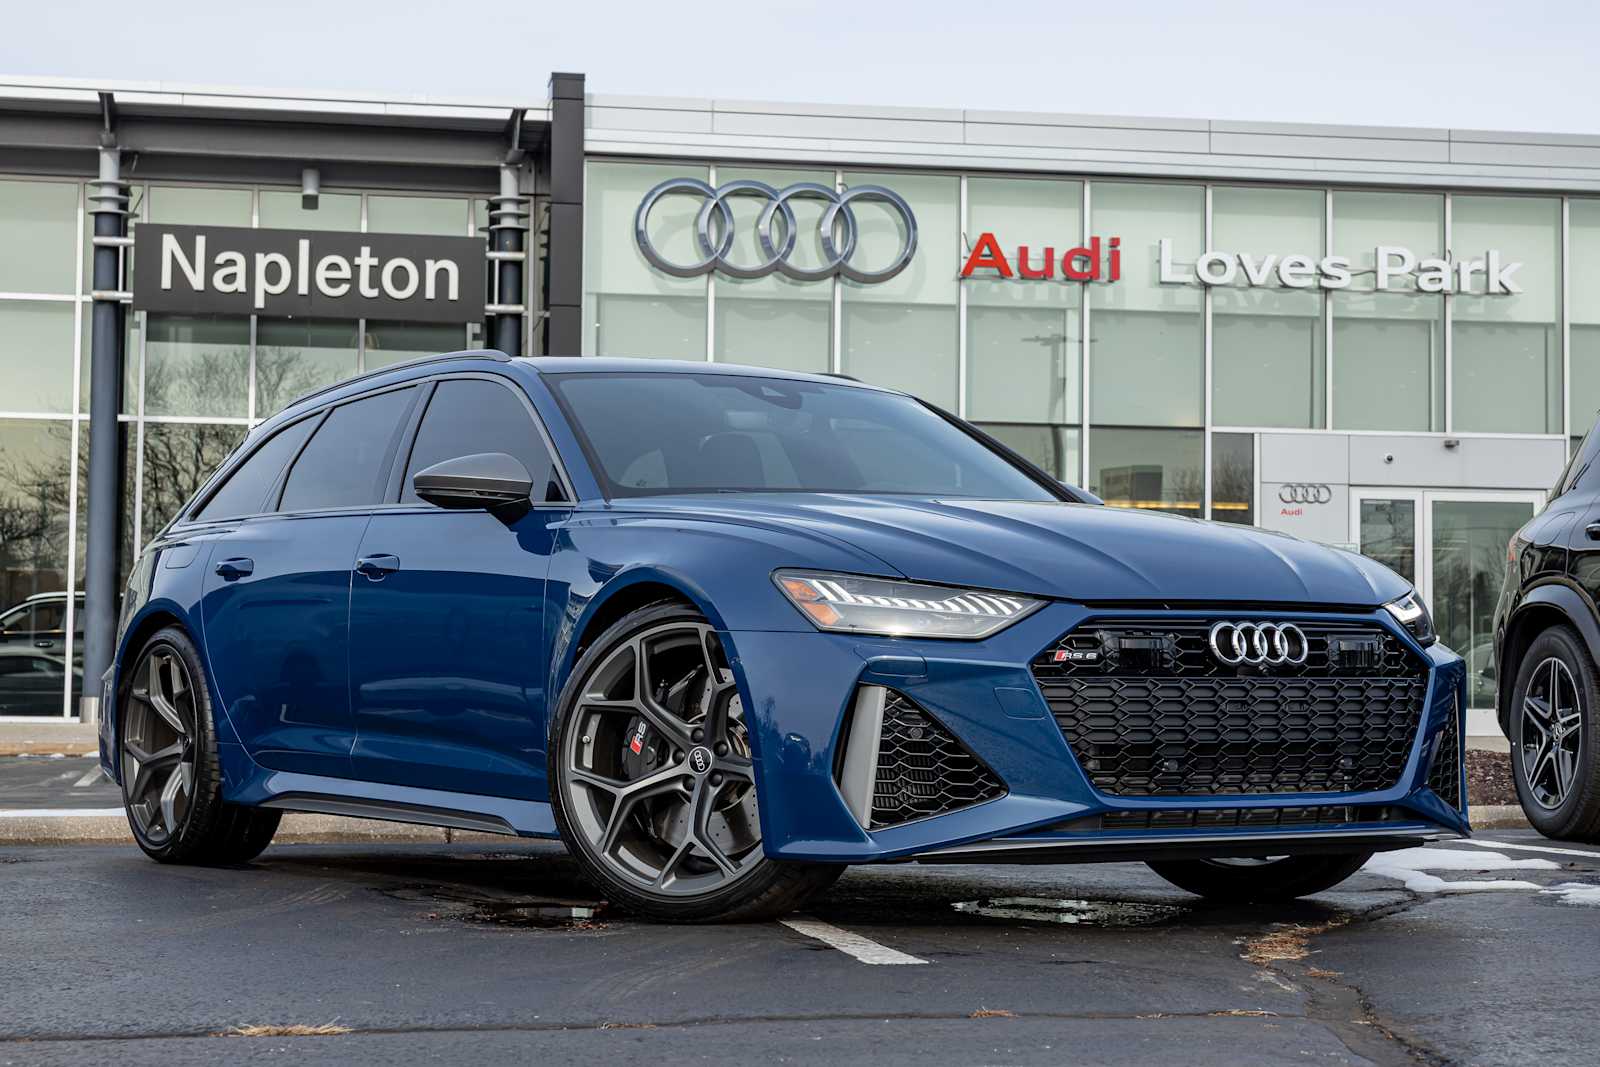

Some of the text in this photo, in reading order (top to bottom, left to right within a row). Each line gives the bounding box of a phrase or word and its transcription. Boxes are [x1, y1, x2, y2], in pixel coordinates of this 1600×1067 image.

[160, 233, 460, 309] Napleton
[960, 232, 1524, 295] Audi Loves Park
[1280, 508, 1303, 516] Audi
